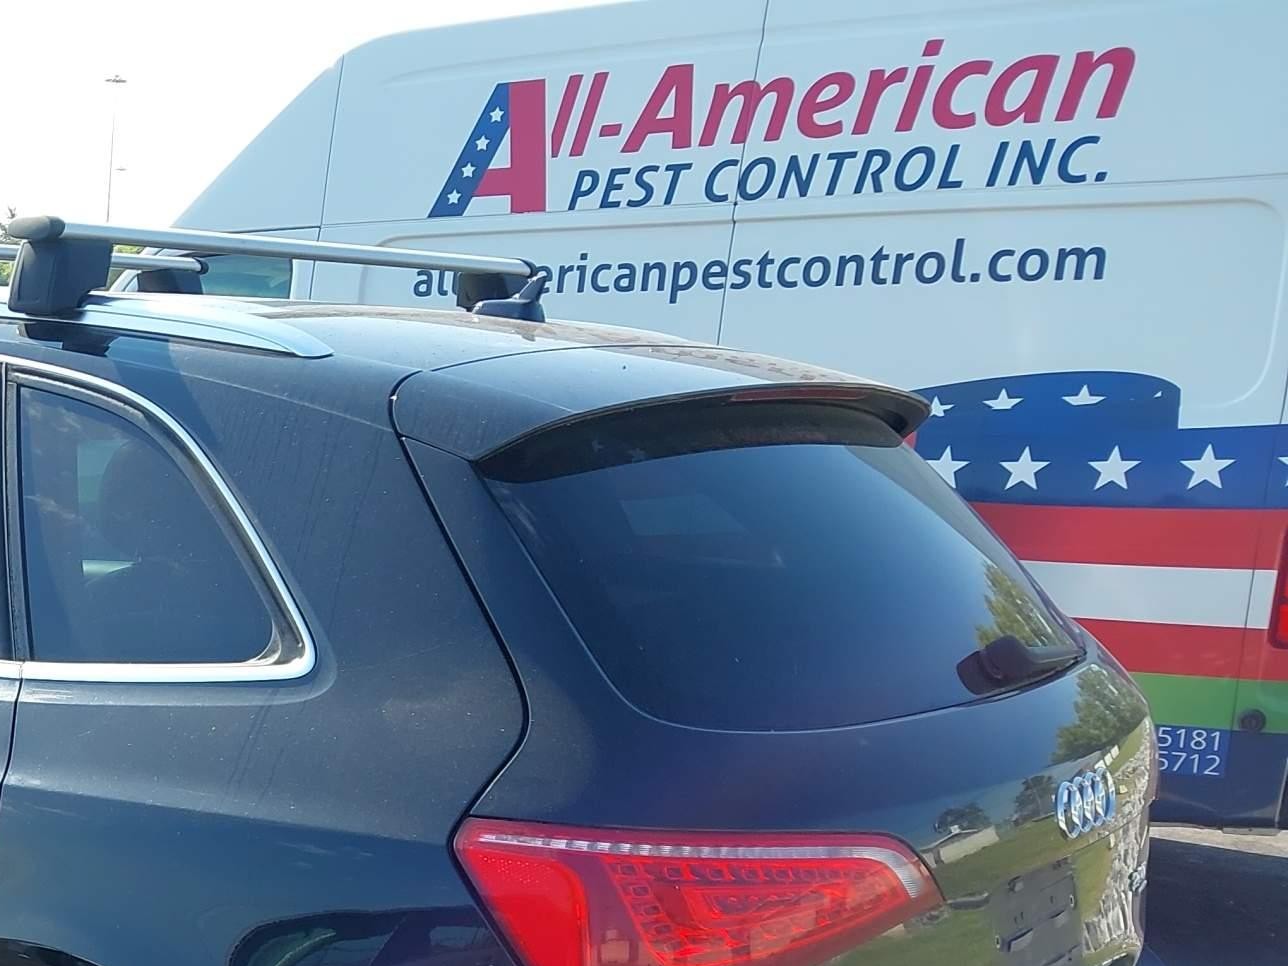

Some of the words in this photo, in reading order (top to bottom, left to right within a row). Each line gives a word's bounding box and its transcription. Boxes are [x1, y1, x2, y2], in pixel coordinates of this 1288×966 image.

[426, 38, 1136, 218] All-American
[567, 162, 692, 211] PEST
[703, 143, 964, 204] CONTROL
[985, 135, 1109, 188] INC.
[413, 238, 1107, 304] allericanpestcontrol.com
[1158, 726, 1221, 752] 5181
[1158, 750, 1221, 776] 5712
